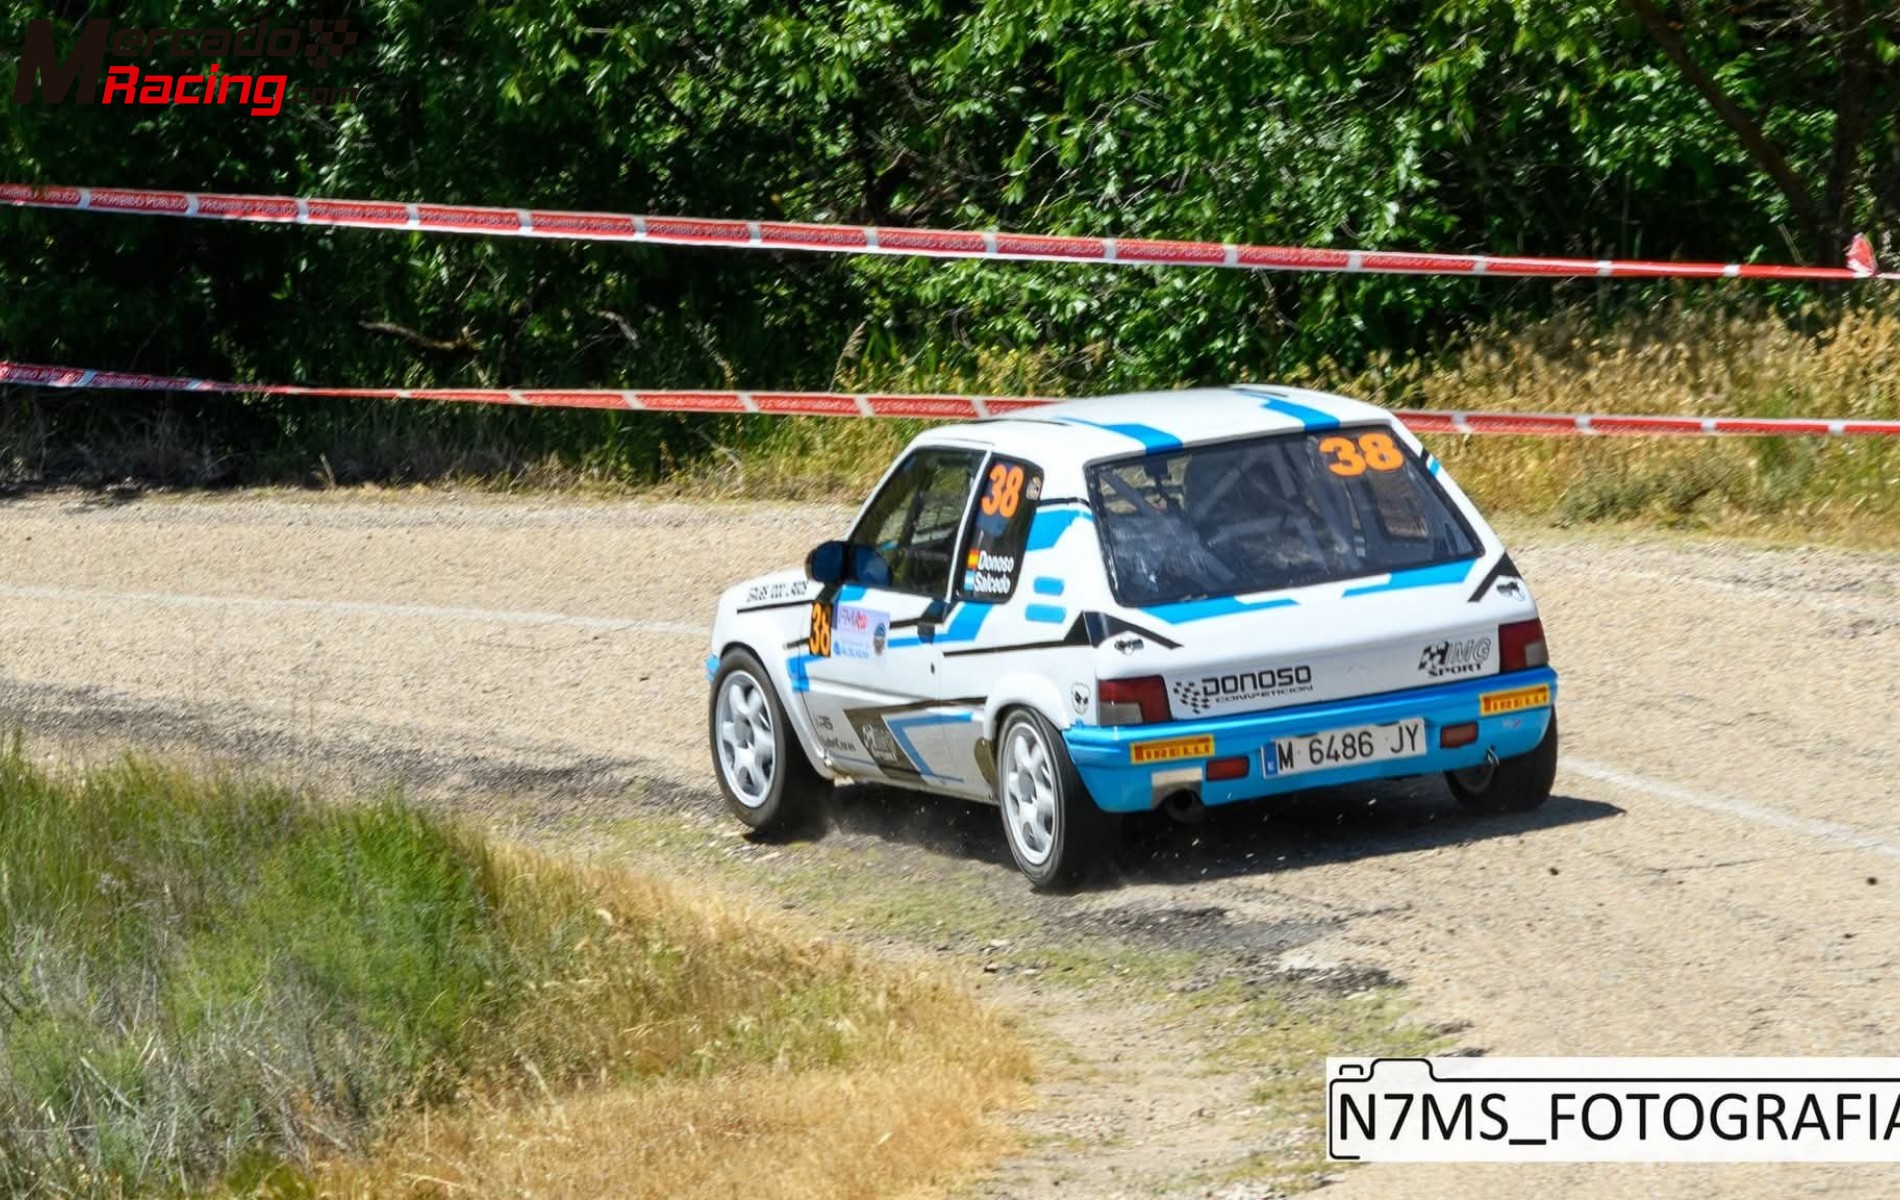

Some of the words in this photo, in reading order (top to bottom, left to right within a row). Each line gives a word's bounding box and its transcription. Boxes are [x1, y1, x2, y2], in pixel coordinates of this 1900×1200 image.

[1318, 432, 1404, 477] 38
[981, 462, 1024, 518] 38
[977, 550, 1015, 573] Donoso
[974, 571, 1011, 594] Salcedo
[1202, 665, 1312, 696] DONOSO
[1427, 662, 1482, 677] SPORT
[1483, 686, 1548, 713] PIRELLI
[1134, 737, 1210, 761] PIRELLI
[1277, 740, 1295, 771] M
[1308, 731, 1374, 765] 6486
[1390, 724, 1419, 753] JY
